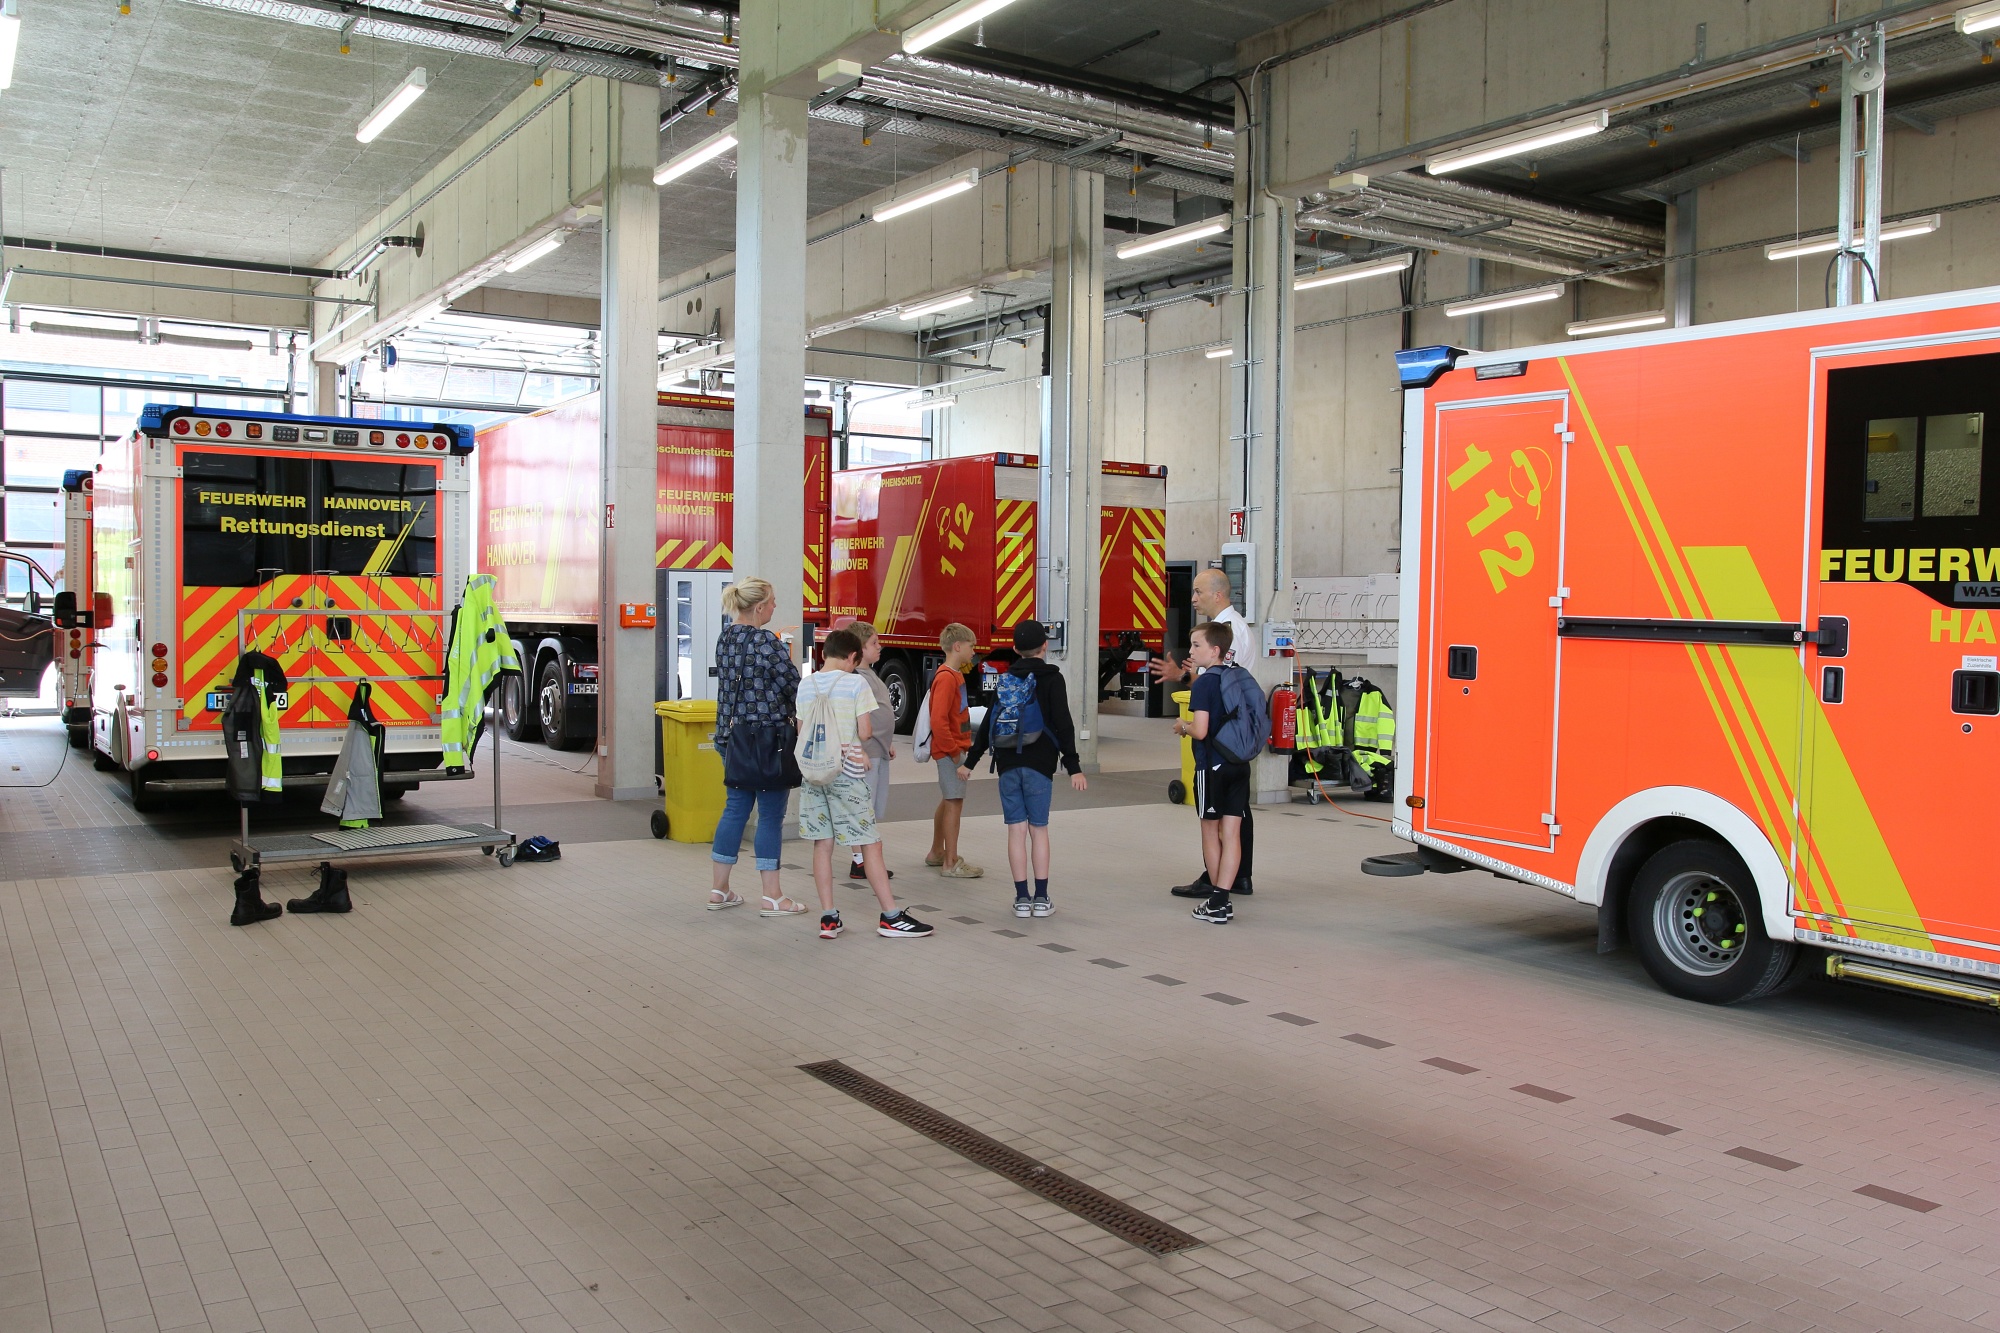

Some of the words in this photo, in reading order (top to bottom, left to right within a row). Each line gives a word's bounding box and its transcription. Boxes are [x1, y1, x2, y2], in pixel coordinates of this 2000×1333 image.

[200, 491, 306, 508] FEUERWEHR
[324, 496, 412, 512] HANNOVER
[656, 503, 715, 516] ANNOVER
[220, 516, 386, 539] Rettungsdienst
[489, 501, 544, 532] FEUERWEHR
[1447, 443, 1535, 594] 112
[833, 536, 885, 550] FEUERWEHR
[940, 502, 974, 577] 112
[486, 540, 536, 567] HANNOVER
[831, 557, 868, 571] ANNOVER
[1820, 548, 2000, 582] FEUERW
[1930, 609, 1997, 644] HA
[216, 695, 224, 707] H
